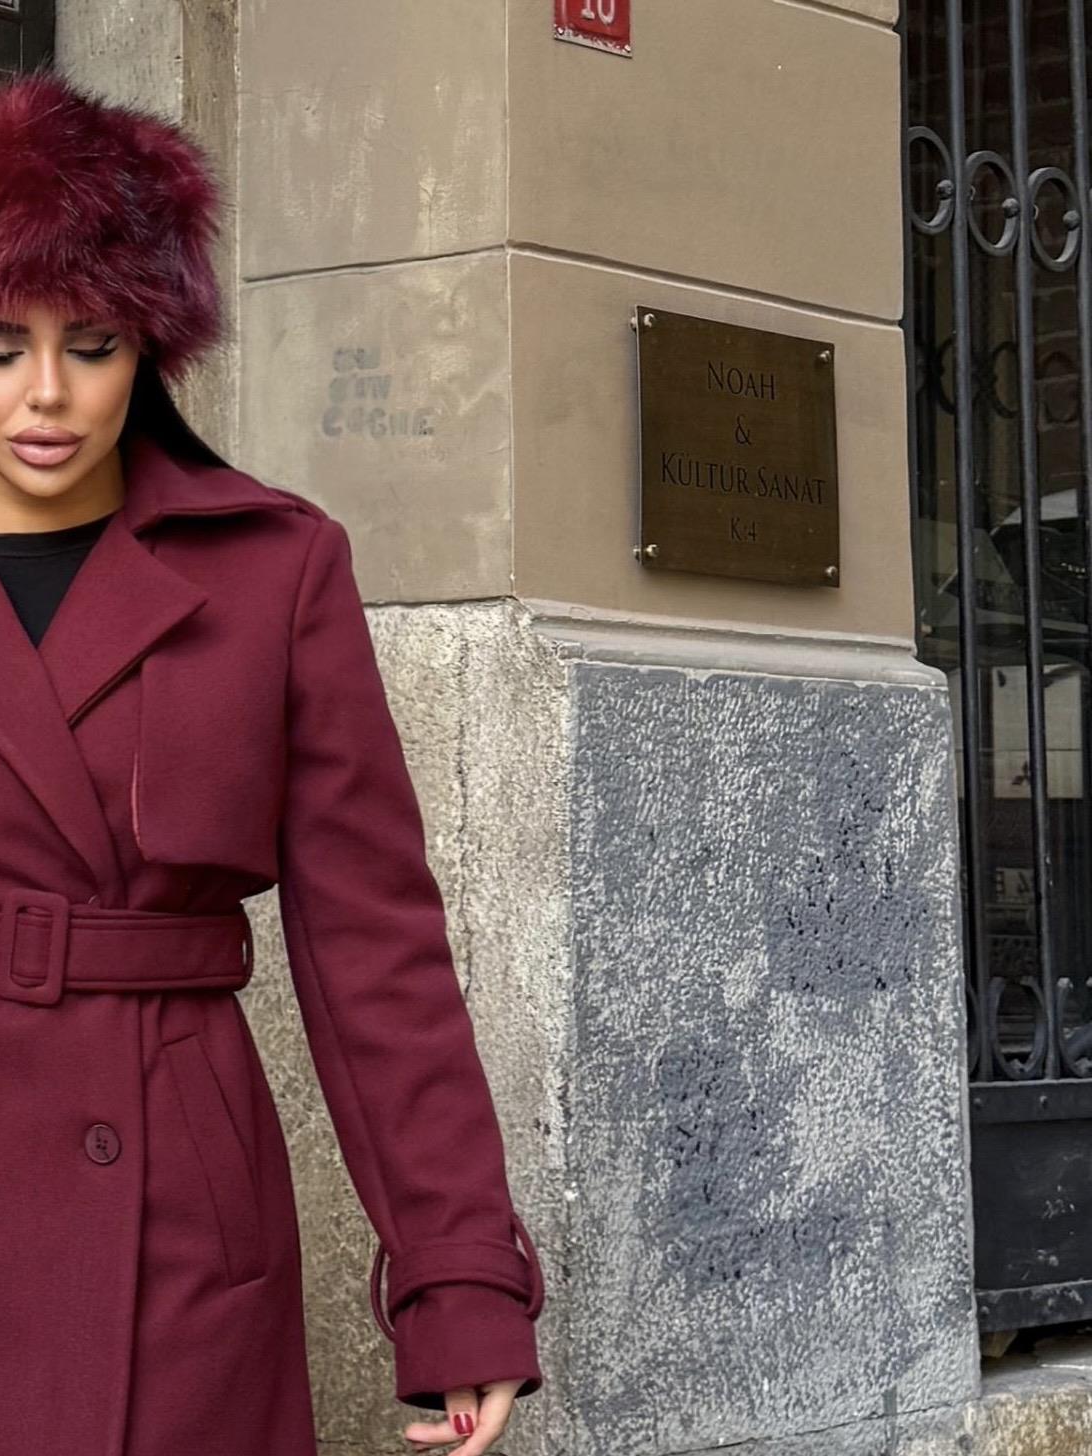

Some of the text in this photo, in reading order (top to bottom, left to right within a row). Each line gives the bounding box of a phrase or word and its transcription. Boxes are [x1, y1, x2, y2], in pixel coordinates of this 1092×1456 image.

[707, 359, 775, 400] NOAH
[734, 413, 753, 445] &
[756, 464, 827, 505] SANAT
